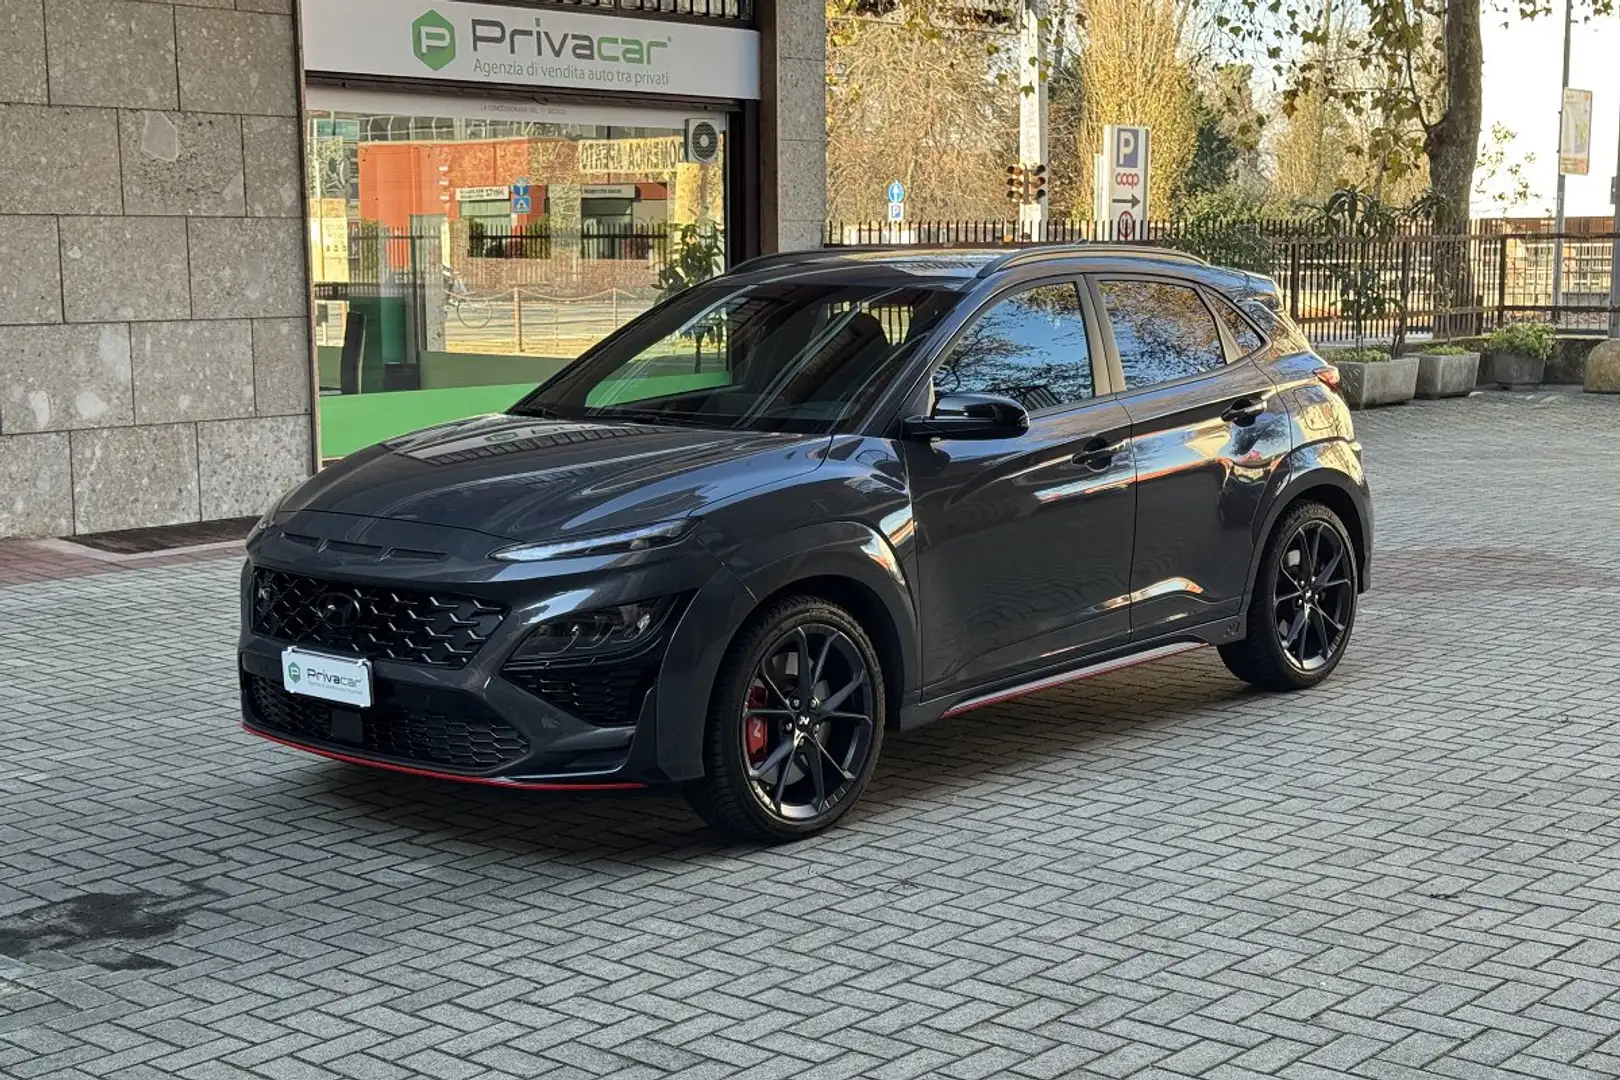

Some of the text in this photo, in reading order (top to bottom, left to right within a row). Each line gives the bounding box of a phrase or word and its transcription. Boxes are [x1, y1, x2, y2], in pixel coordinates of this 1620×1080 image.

[420, 26, 451, 54] P
[471, 17, 668, 65] Privacar
[473, 58, 669, 86] Agenzia di vendita auto tra privati
[1119, 131, 1135, 165] P
[1115, 172, 1140, 190] coop
[306, 668, 363, 688] Privacar
